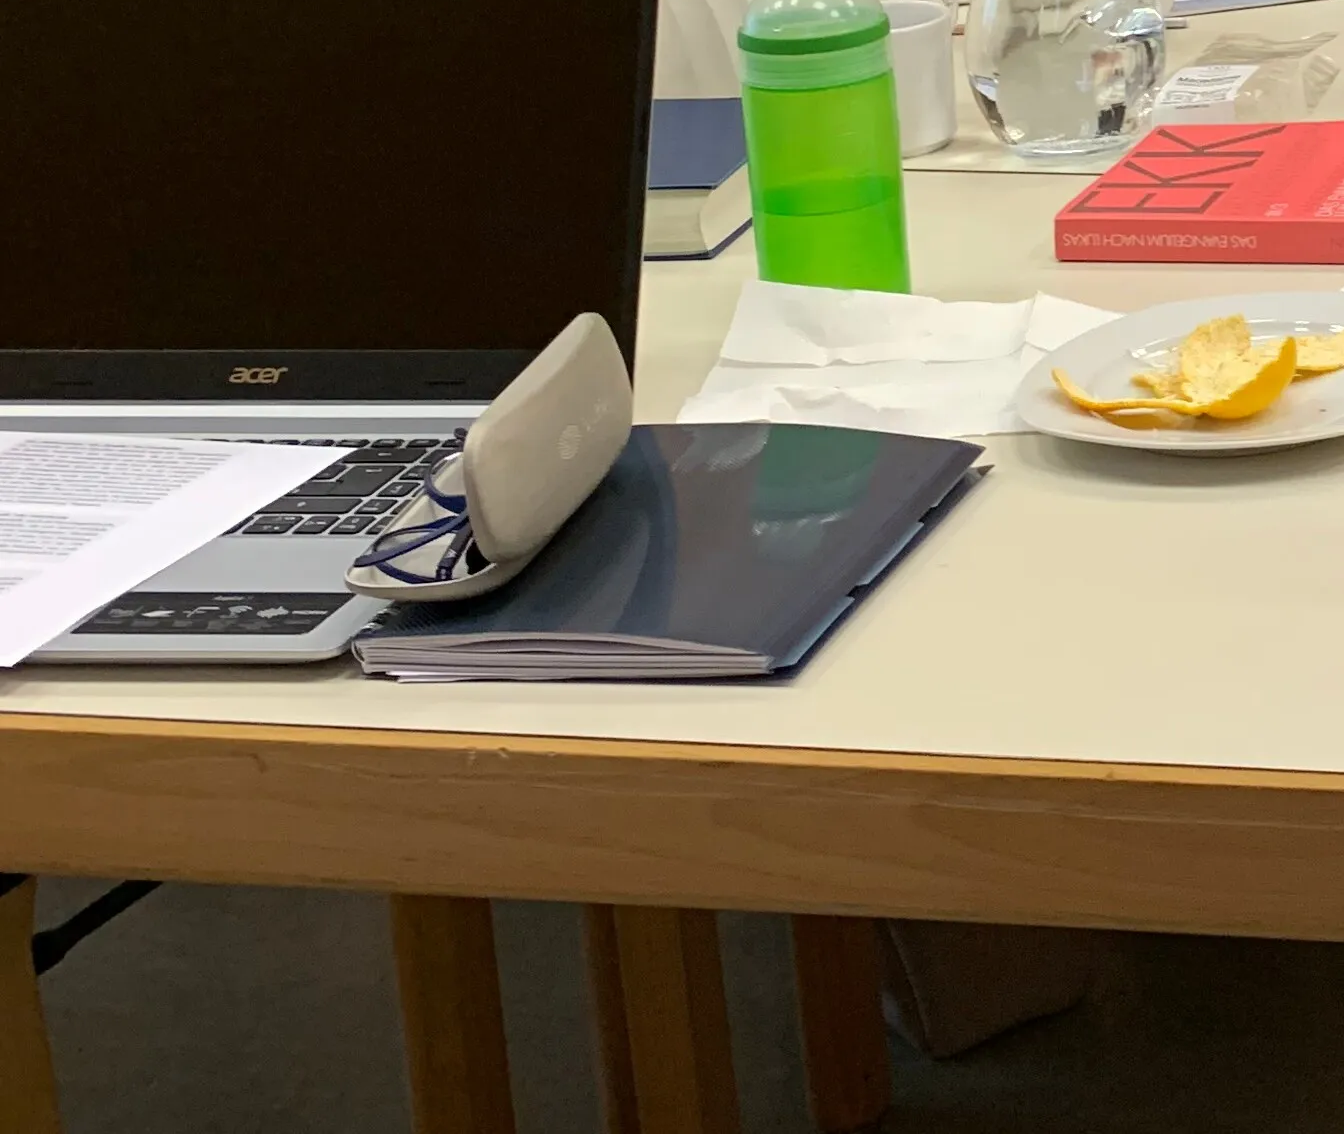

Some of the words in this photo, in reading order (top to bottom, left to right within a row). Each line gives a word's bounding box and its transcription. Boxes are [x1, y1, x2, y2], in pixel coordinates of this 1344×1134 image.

[1069, 125, 1290, 214] EKK
[1062, 233, 1102, 248] LUKAS
[1104, 233, 1145, 248] NACH
[1146, 233, 1228, 250] EVANGELIUM
[1231, 235, 1258, 250] DAS
[228, 366, 288, 385] acer
